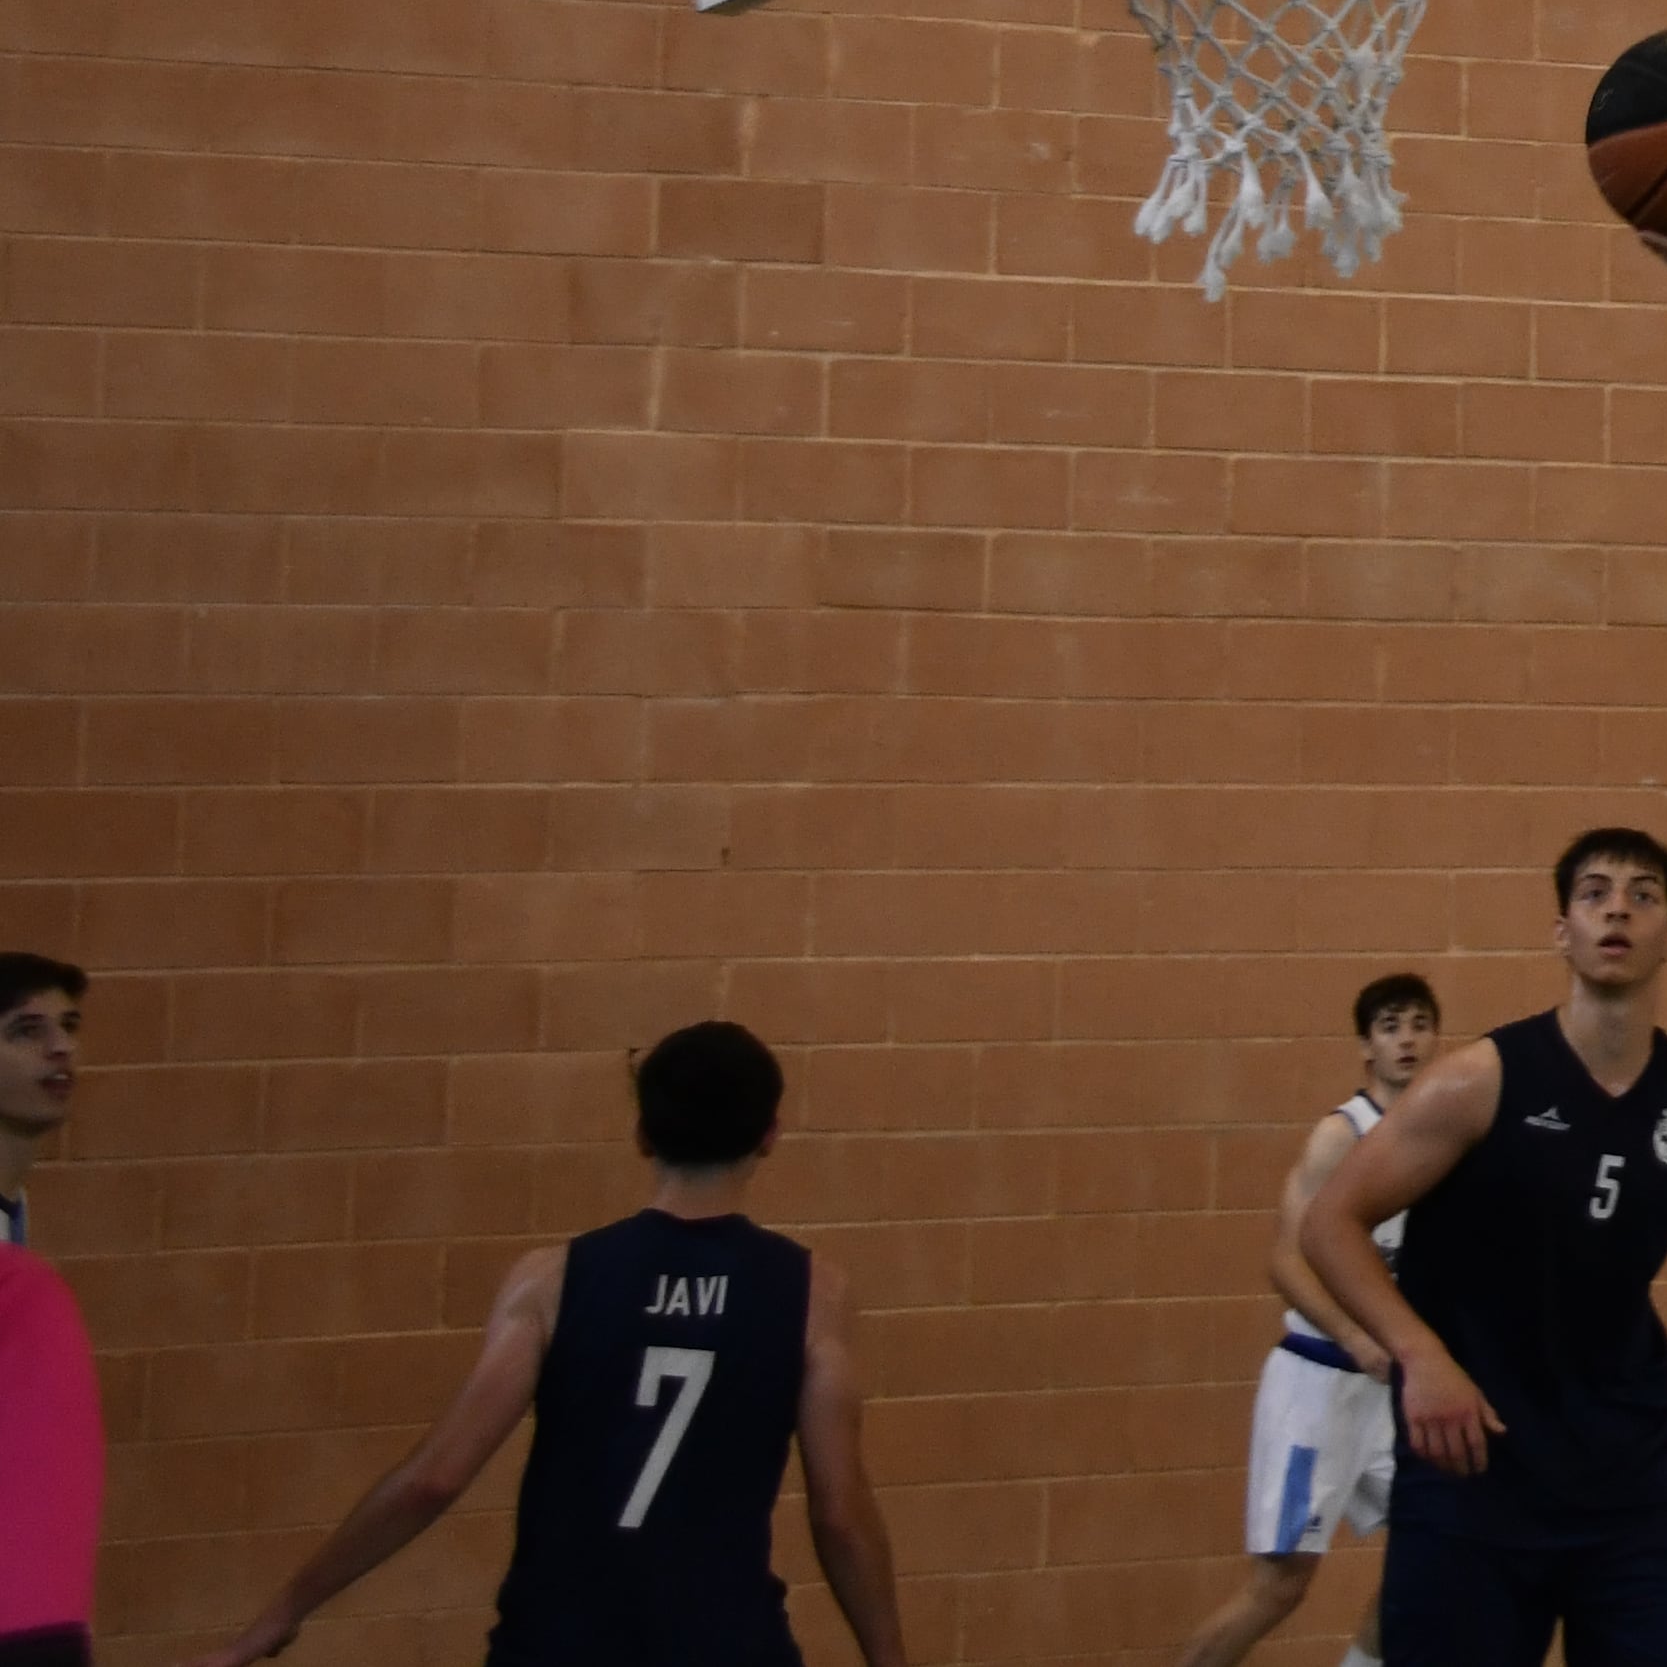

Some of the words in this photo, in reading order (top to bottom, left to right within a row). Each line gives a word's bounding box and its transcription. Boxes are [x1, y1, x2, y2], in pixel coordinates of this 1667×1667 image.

[1589, 1153, 1626, 1219] 5
[644, 1274, 729, 1316] JAVI
[617, 1346, 716, 1529] 7
